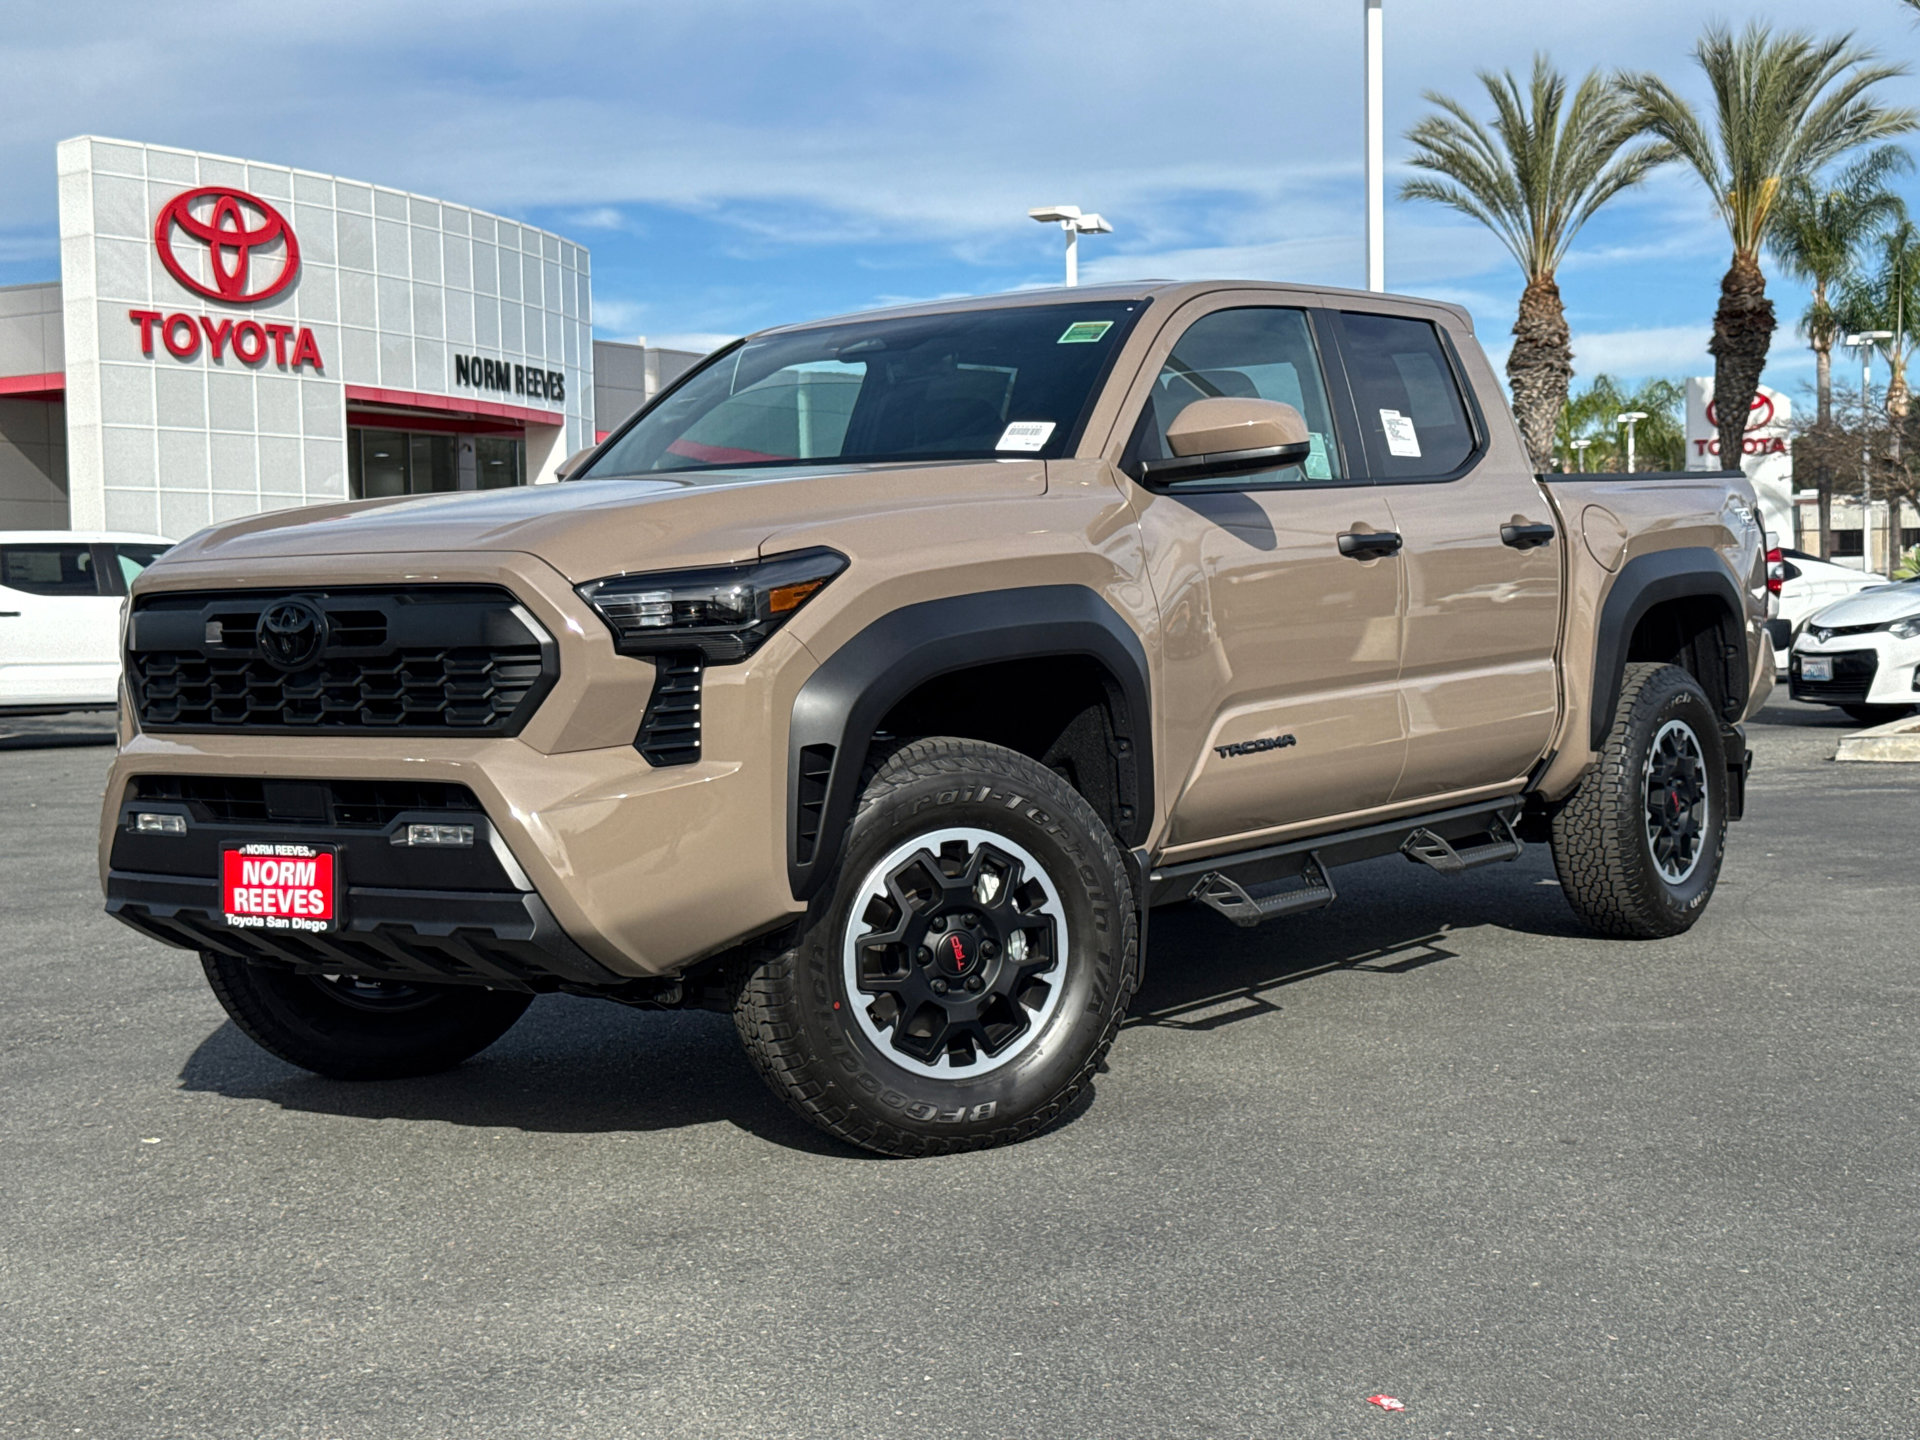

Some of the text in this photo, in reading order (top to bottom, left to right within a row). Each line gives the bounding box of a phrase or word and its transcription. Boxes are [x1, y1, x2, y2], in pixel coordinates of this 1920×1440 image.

[129, 309, 324, 376] TOYOTA
[455, 353, 566, 402] NORM REEVES
[1693, 438, 1786, 456] TOOTA
[1213, 733, 1297, 759] TACOMA
[247, 844, 274, 855] NORM
[242, 861, 317, 886] NORM
[233, 888, 324, 915] REEVES
[226, 914, 328, 932] Toyota San Diego
[950, 936, 968, 972] TRD
